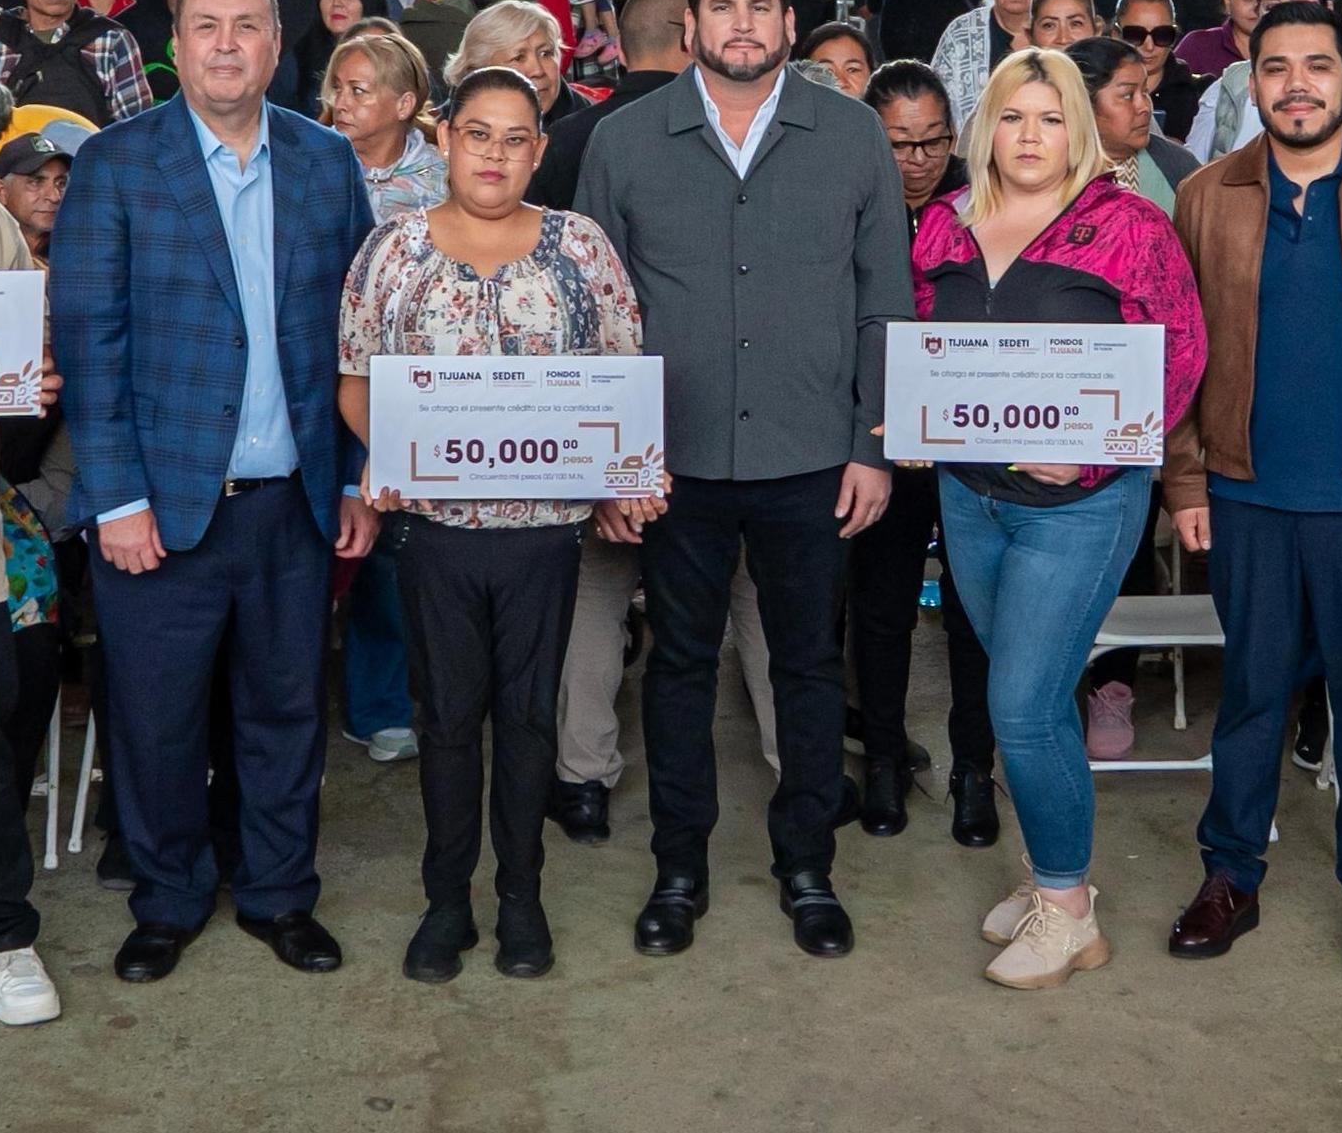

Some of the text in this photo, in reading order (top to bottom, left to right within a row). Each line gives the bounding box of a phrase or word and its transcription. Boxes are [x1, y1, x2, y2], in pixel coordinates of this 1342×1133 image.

[948, 339, 989, 347] TIJUANA
[998, 338, 1029, 347] SEDETI
[439, 372, 482, 380] TIJUANA
[492, 371, 525, 380] SEDETI
[546, 370, 580, 378] FONDOS
[1064, 422, 1093, 432] pesos
[563, 456, 593, 465] pesos
